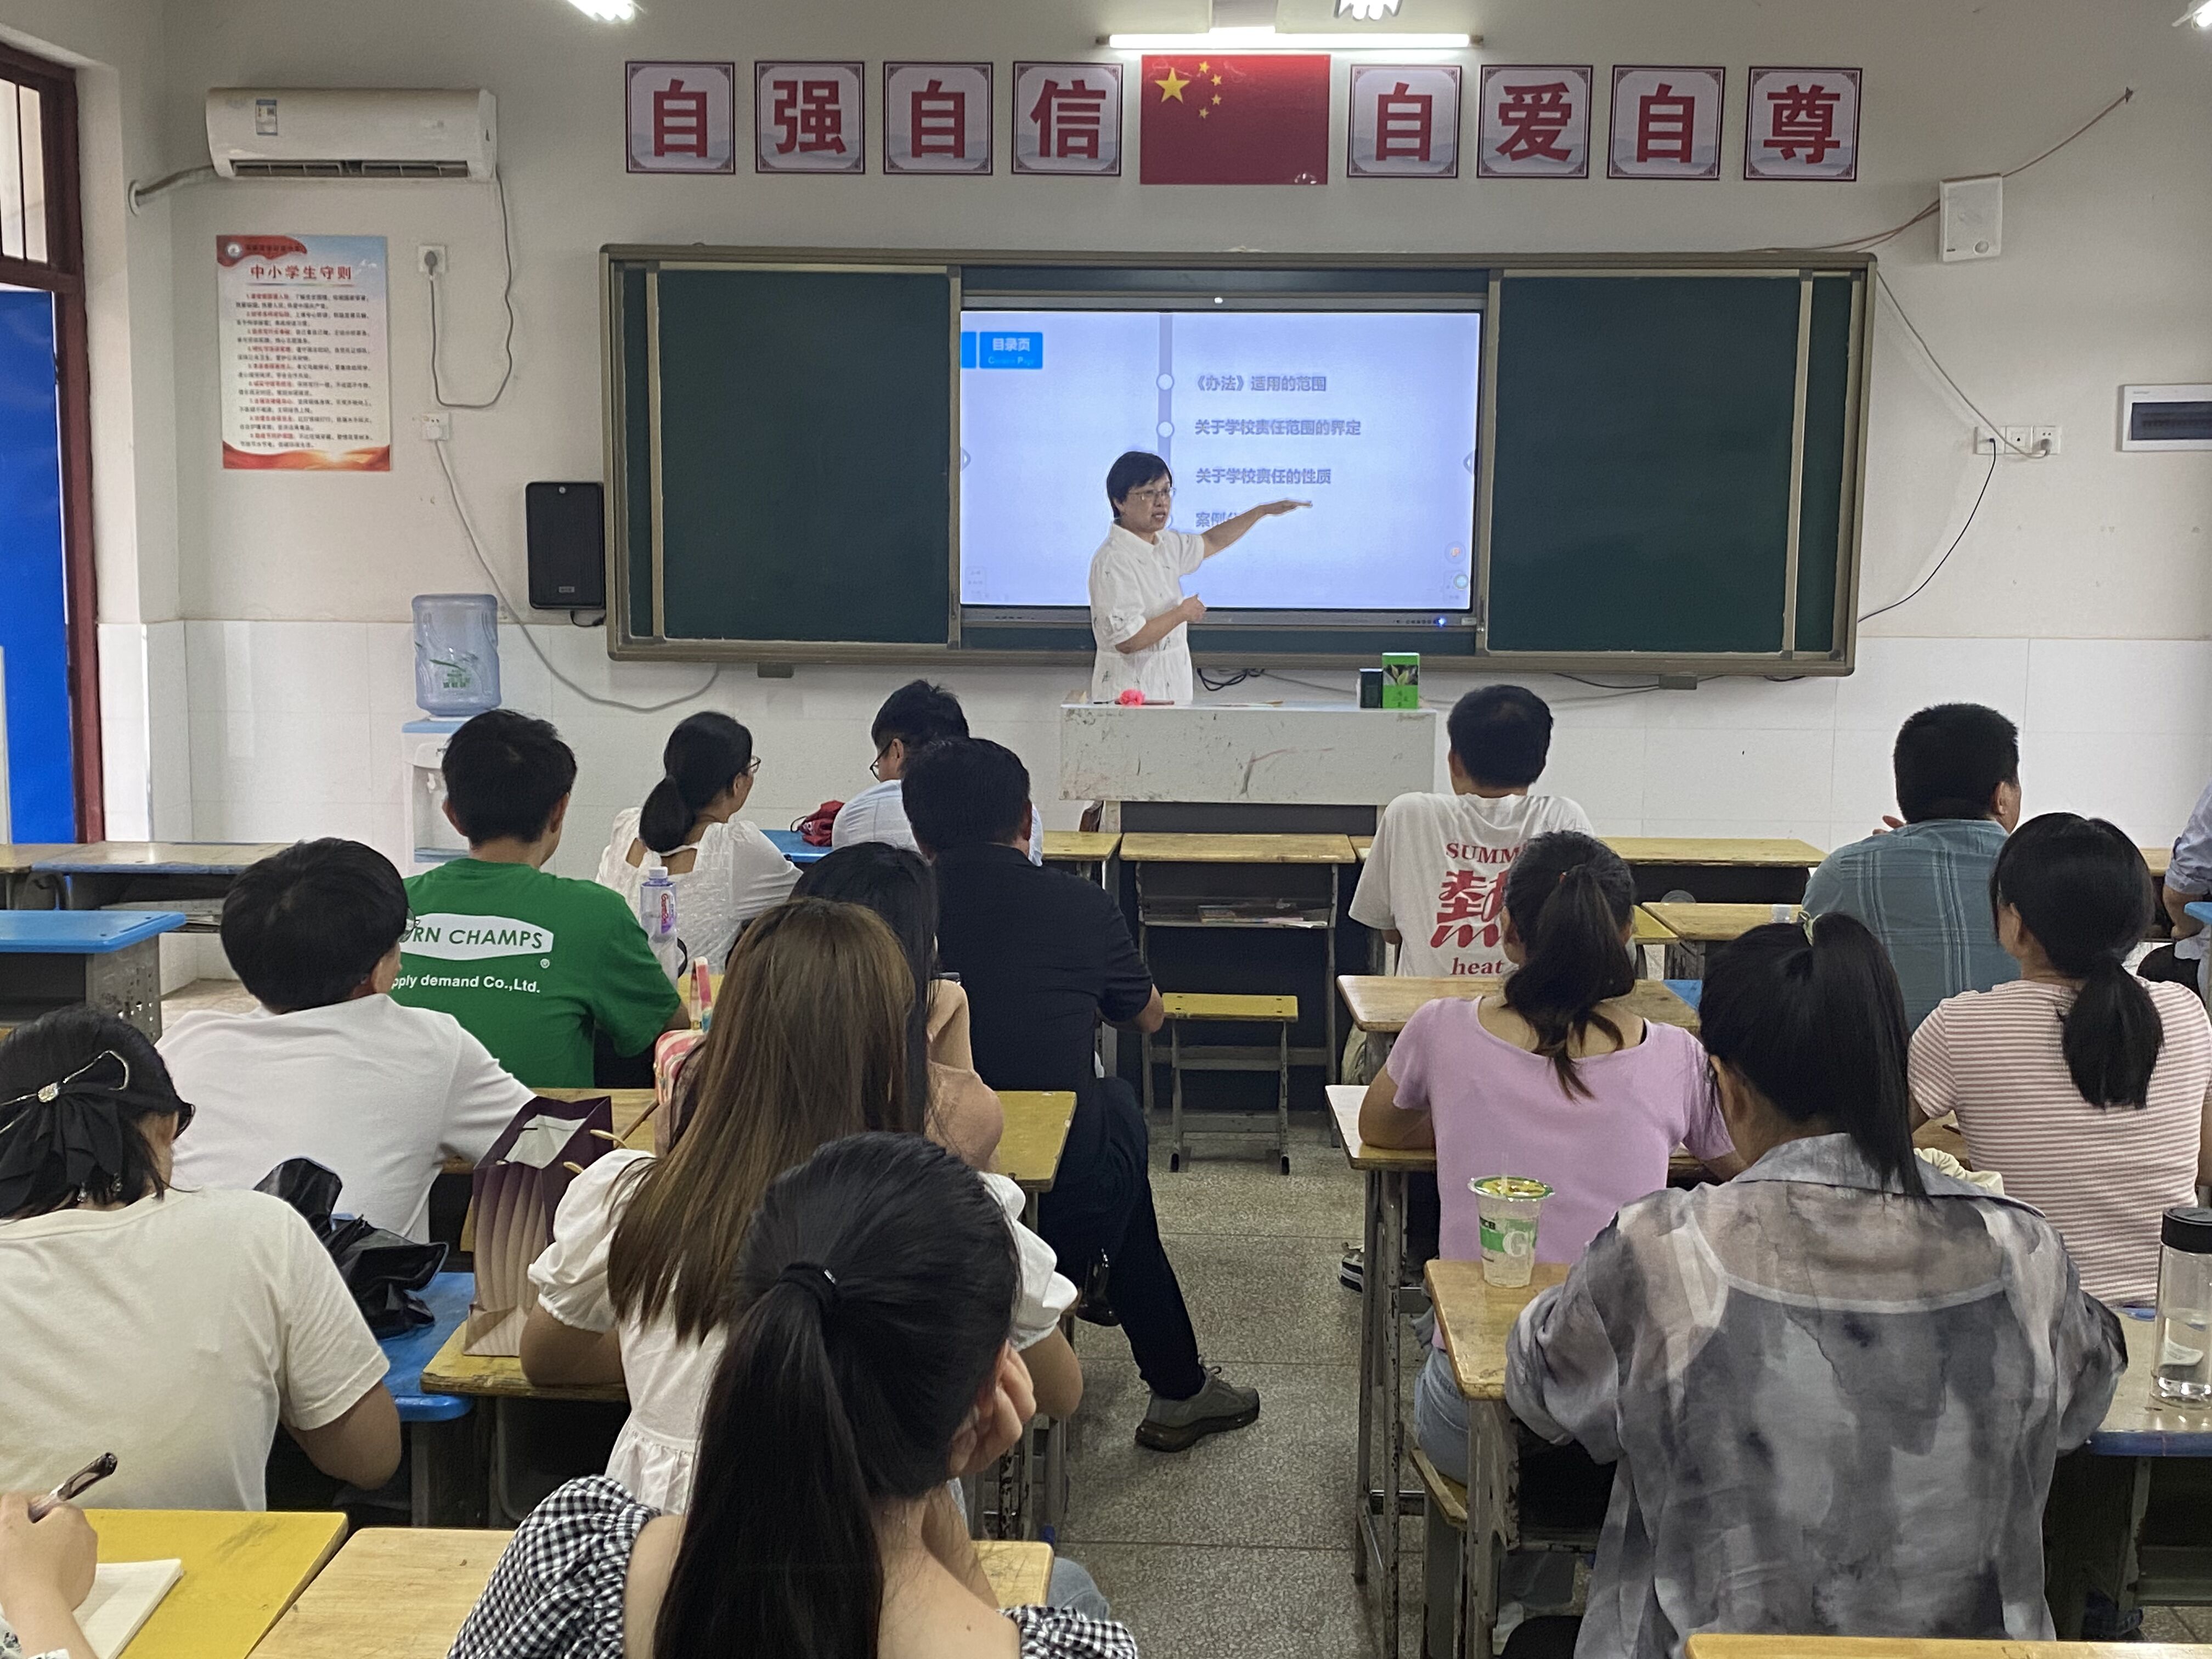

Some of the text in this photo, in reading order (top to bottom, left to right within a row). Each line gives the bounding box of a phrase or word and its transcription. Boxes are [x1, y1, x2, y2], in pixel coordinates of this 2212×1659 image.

[250, 264, 352, 280] 中小学生守则
[992, 338, 1031, 352] 目录页
[1196, 375, 1327, 392] 《办法》适用的范围
[1195, 419, 1362, 436] 关于学校责任范围的界定
[1195, 467, 1332, 484] 关于学校责任的性质
[1446, 842, 1528, 864] SUMM
[407, 926, 543, 949] RN CHAMPS
[1450, 957, 1504, 975] heat
[391, 974, 541, 994] pply demand Co.,Ltd.
